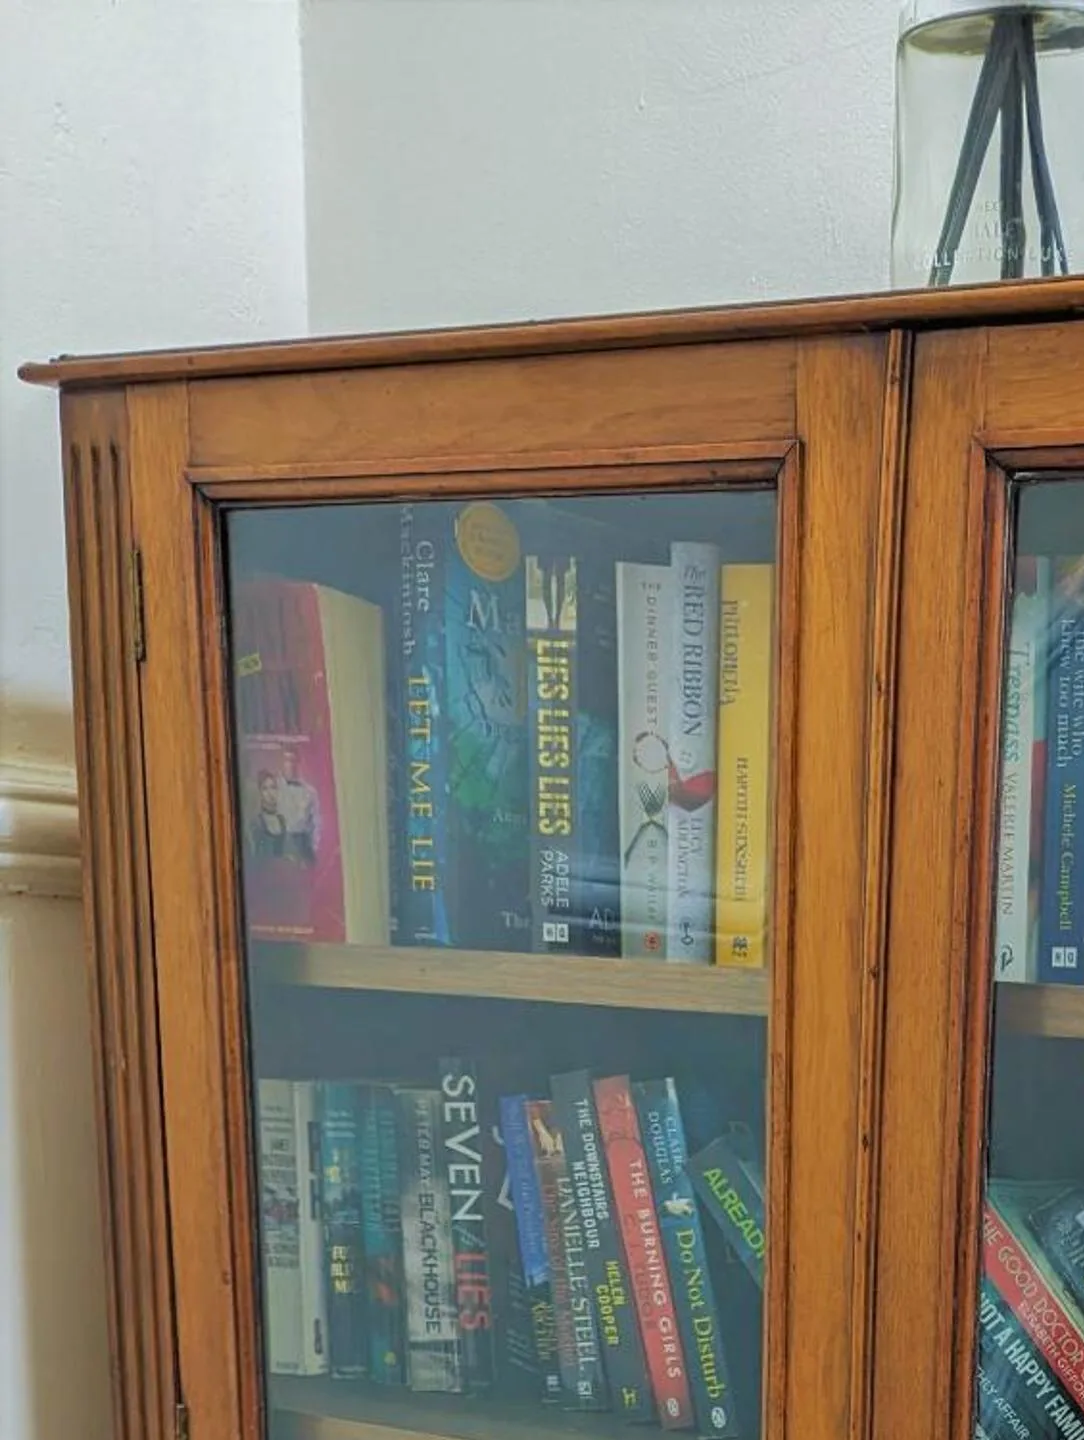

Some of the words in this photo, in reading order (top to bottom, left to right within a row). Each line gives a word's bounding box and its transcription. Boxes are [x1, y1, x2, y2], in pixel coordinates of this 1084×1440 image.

[683, 583, 705, 637] RED
[537, 638, 570, 701] LIES
[682, 643, 704, 737] RIBBON
[1058, 675, 1071, 702] too
[408, 675, 431, 743] LET
[537, 708, 571, 769] LIES
[1056, 705, 1074, 769] much
[409, 762, 433, 818] ME
[538, 776, 573, 836] LIES
[1060, 783, 1078, 844] Michele
[411, 838, 437, 892] LIE
[539, 848, 556, 908] PARKS
[554, 850, 571, 907] ADELE
[1057, 850, 1077, 931] Campbell
[573, 1098, 593, 1129] THE
[441, 1074, 486, 1222] SEVEN
[580, 1131, 610, 1222] DOWNSTAIRS
[647, 1110, 674, 1186] DOUGLAS
[570, 1160, 601, 1250] NEIGHBOUR
[628, 1158, 650, 1201] THE
[418, 1192, 442, 1336] BLACKHOUSE
[635, 1205, 670, 1308] BURNING
[675, 1228, 698, 1264] Do
[997, 1240, 1039, 1303] GOOD
[453, 1251, 491, 1331] LIES
[604, 1259, 629, 1307] HELEN
[683, 1266, 704, 1311] Not
[596, 1284, 620, 1346] COOPER
[656, 1314, 683, 1380] GIRLS
[690, 1314, 728, 1400] Disturb
[1003, 1344, 1052, 1403] HAPPY
[994, 1396, 1031, 1440] AFFAIR
